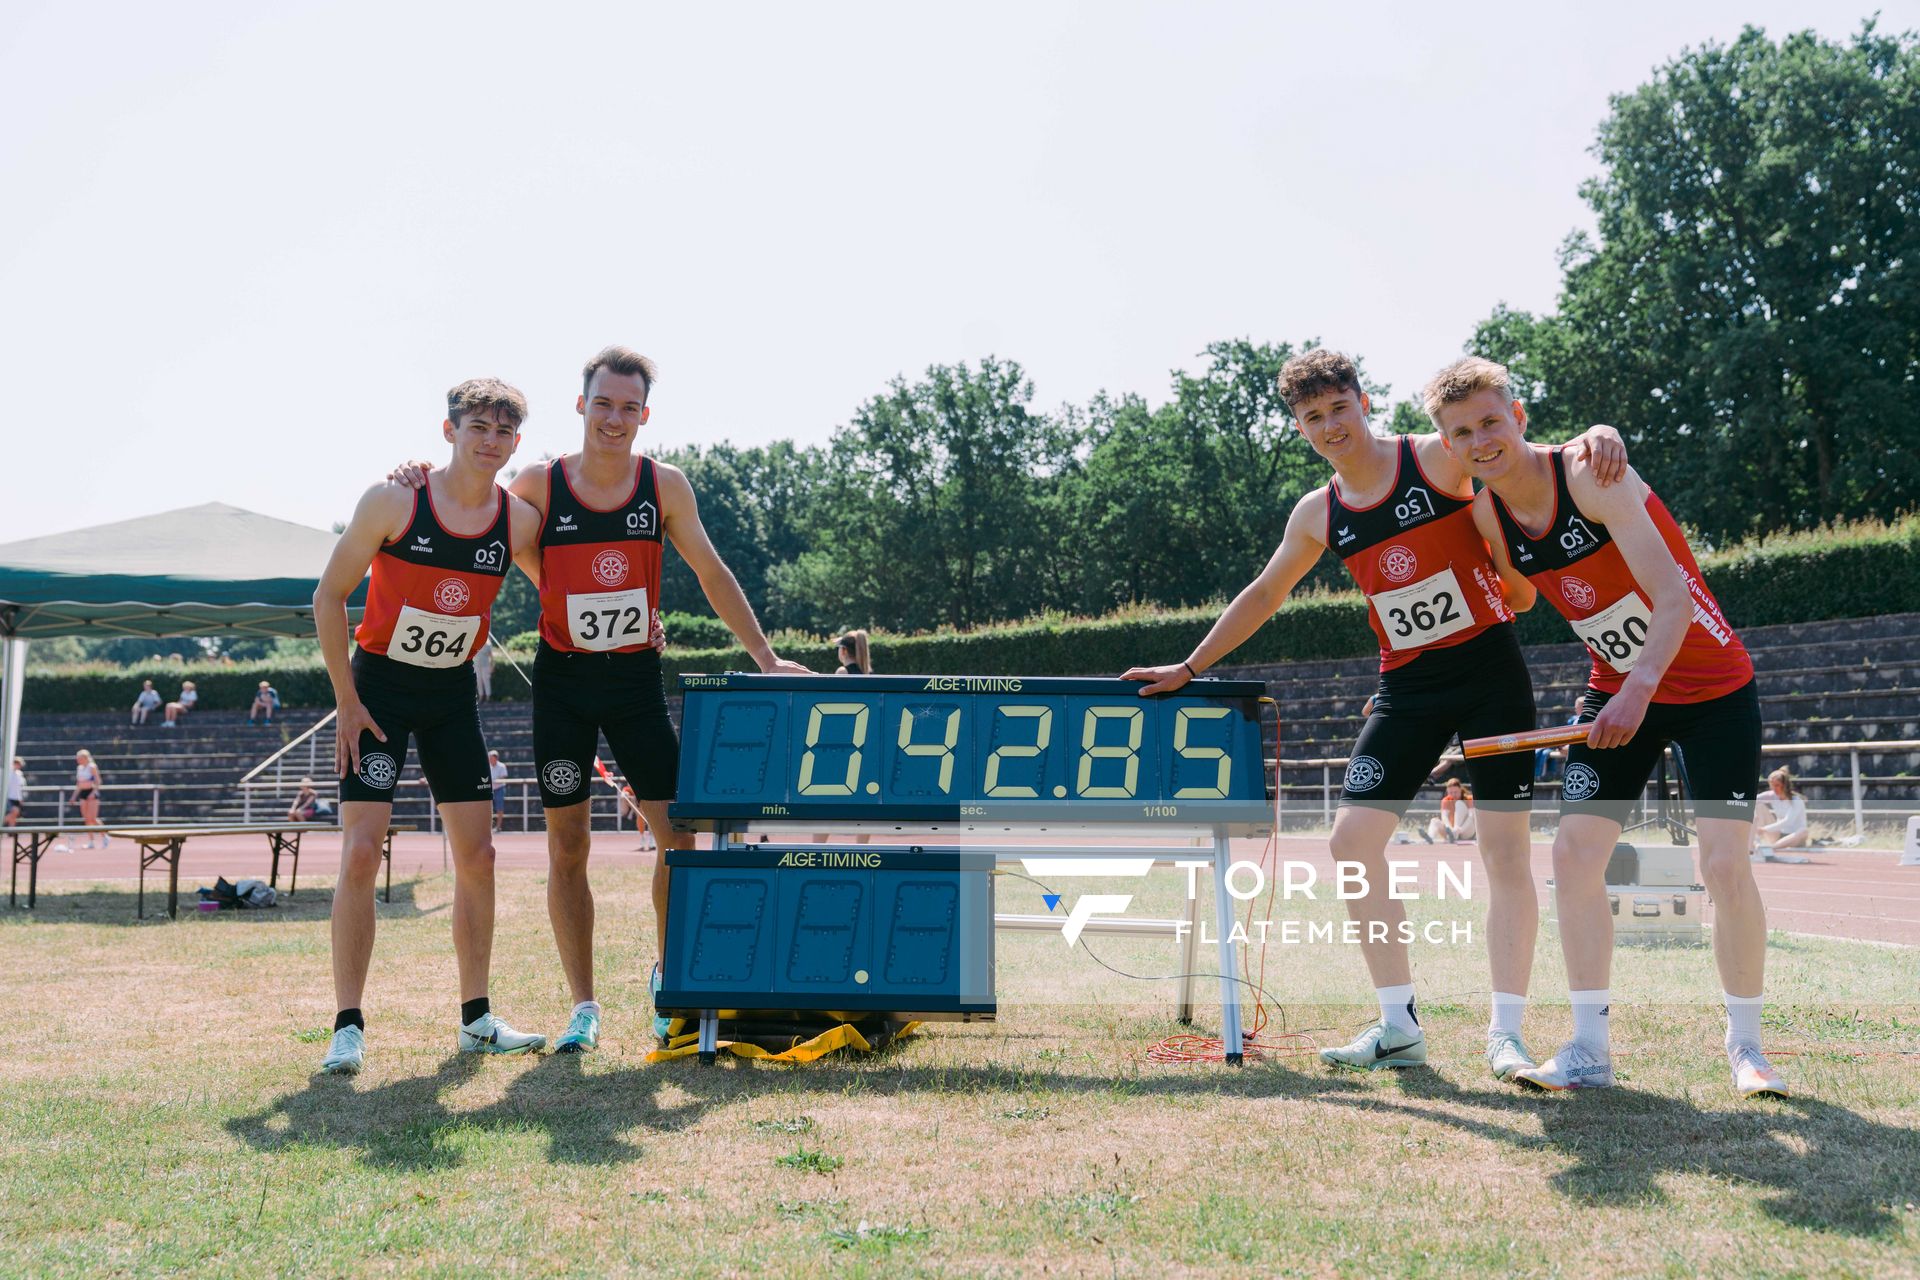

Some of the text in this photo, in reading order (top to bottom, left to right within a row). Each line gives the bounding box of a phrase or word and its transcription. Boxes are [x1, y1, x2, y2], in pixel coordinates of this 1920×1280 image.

[1394, 498, 1421, 520] OS
[626, 512, 648, 528] OS
[556, 524, 578, 532] erima
[1338, 533, 1356, 546] erima
[1560, 528, 1584, 550] OS
[410, 544, 432, 554] erima
[475, 548, 496, 564] OS
[1388, 592, 1460, 637] 362
[580, 606, 641, 640] 372
[401, 626, 468, 658] 364
[924, 678, 1022, 692] ALGE-TIMING
[762, 804, 790, 815] min.
[960, 806, 987, 816] sec.
[1144, 806, 1177, 816] 1/100
[1726, 800, 1748, 808] erima
[778, 852, 882, 868] ALGE-TIMING
